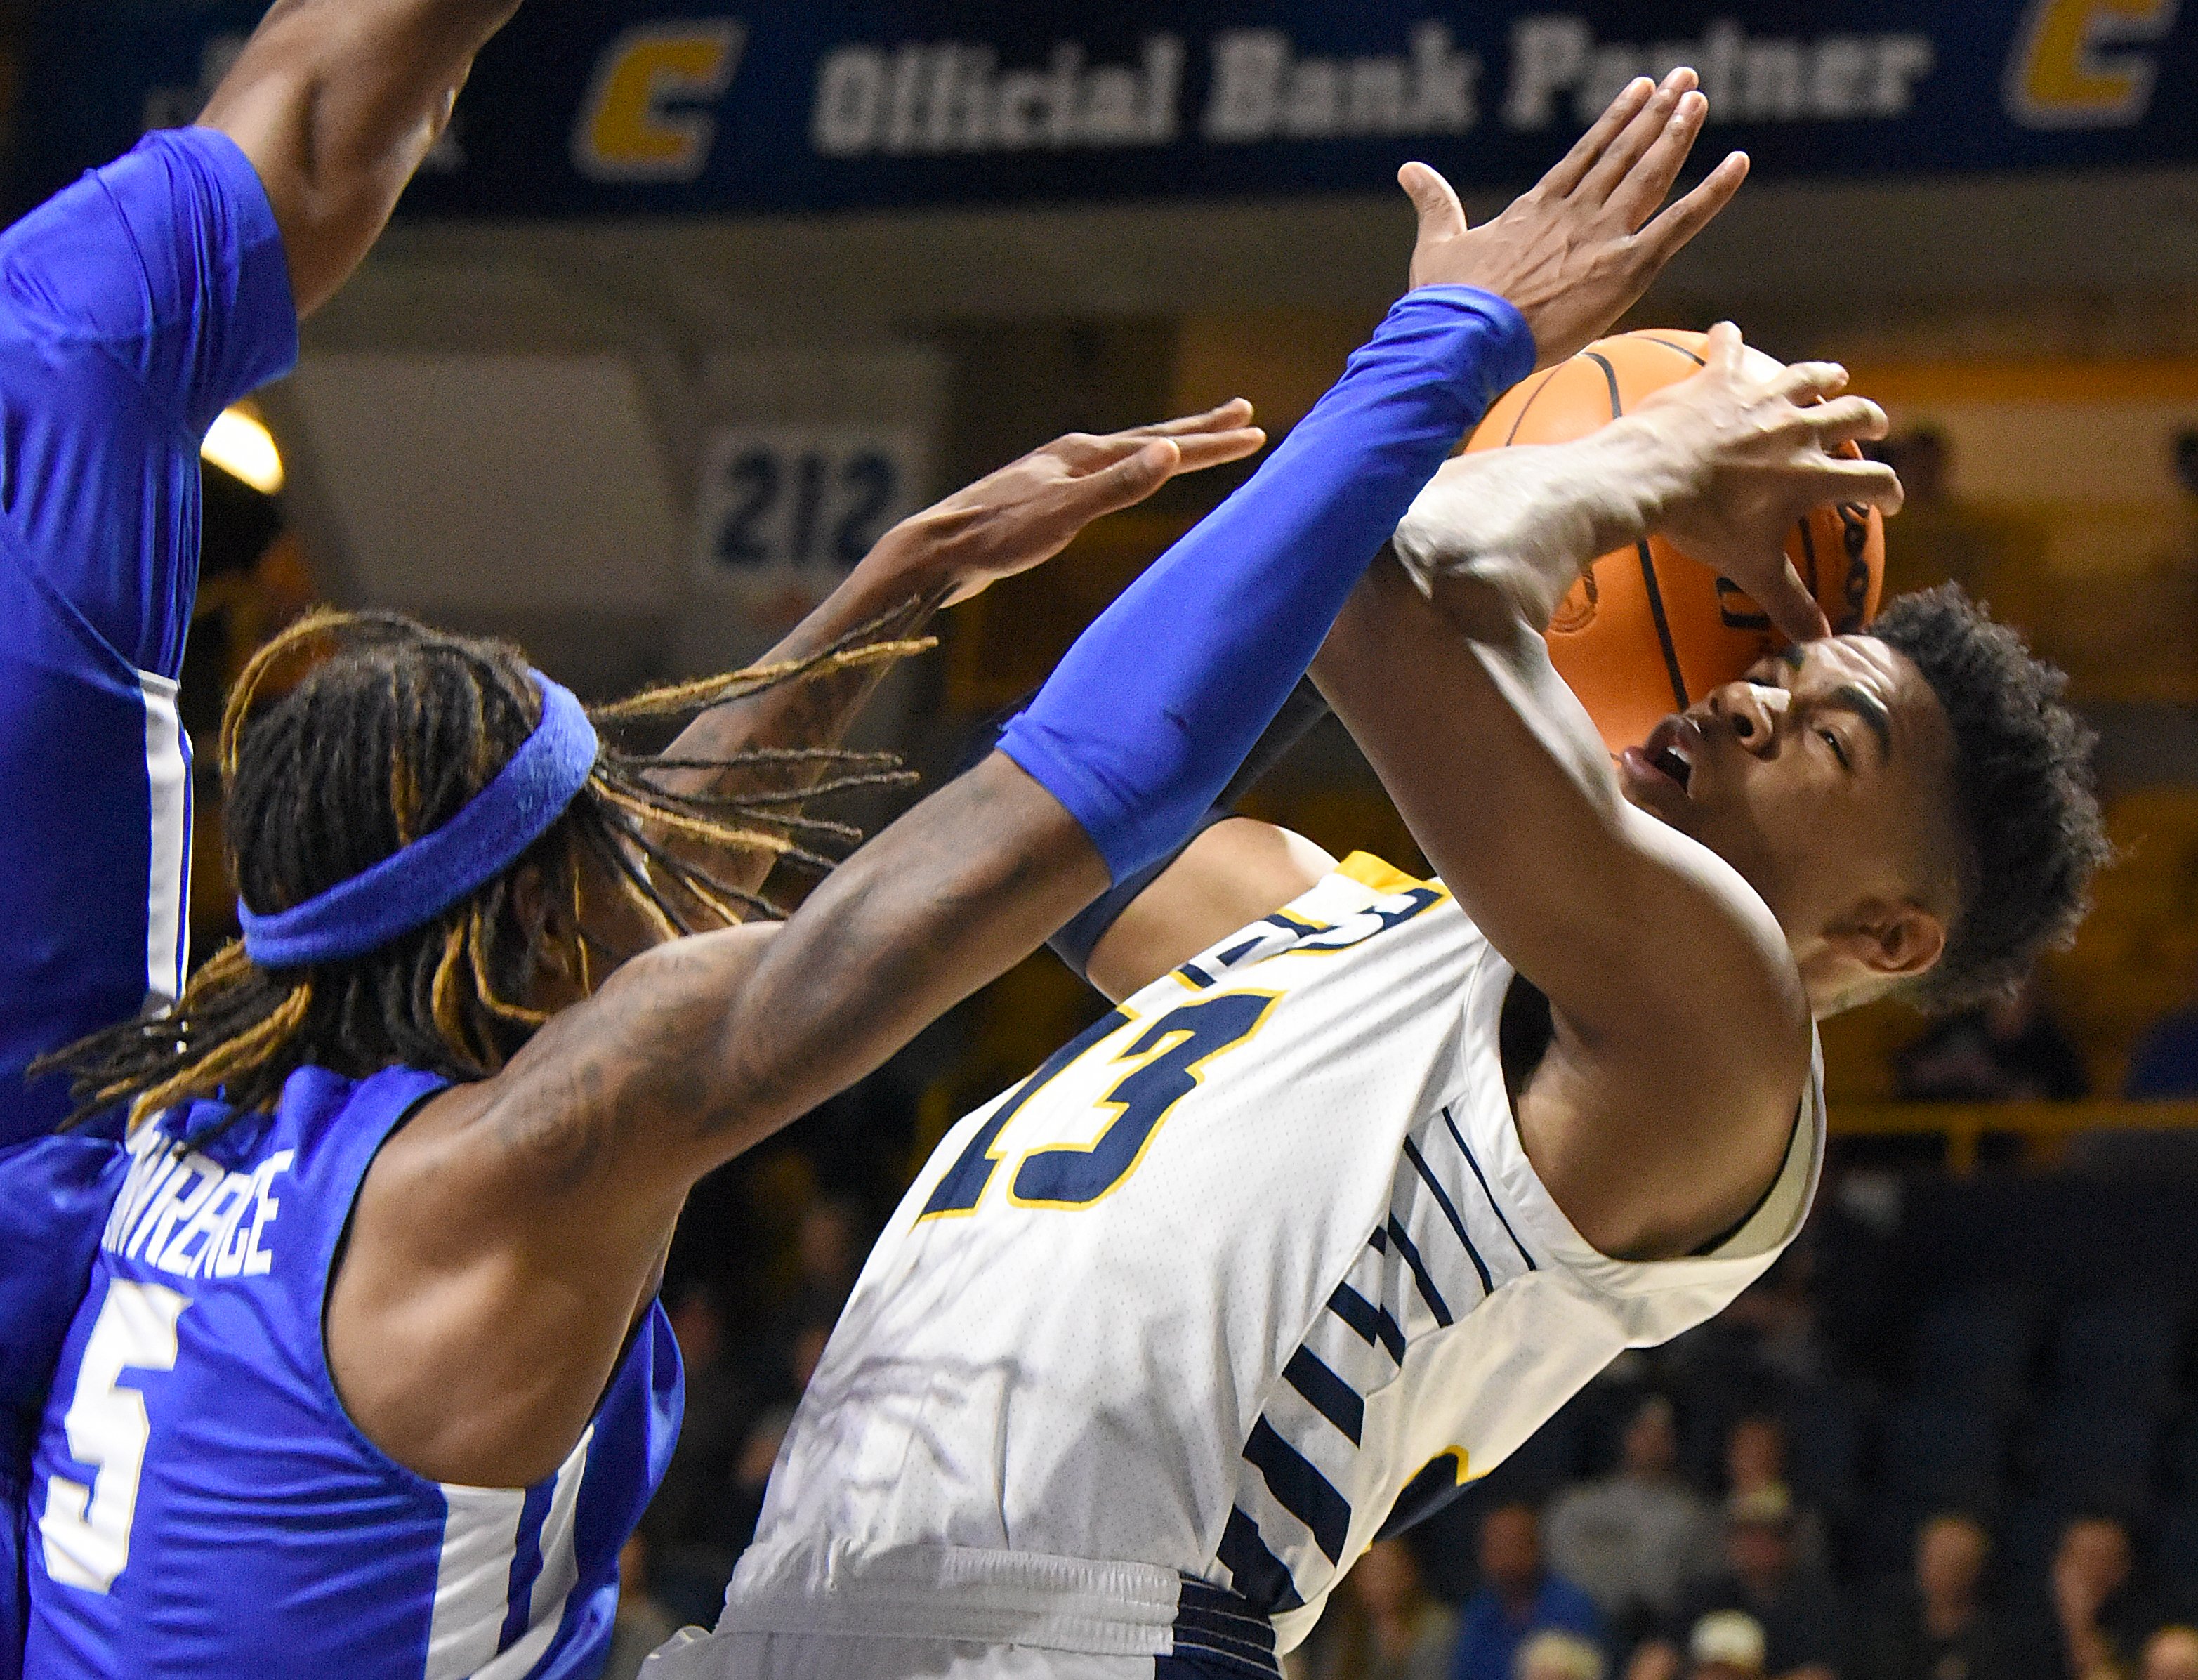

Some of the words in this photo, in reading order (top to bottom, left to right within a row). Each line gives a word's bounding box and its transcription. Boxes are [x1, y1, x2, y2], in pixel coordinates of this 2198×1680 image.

[815, 34, 1181, 156] Official
[1206, 25, 1476, 140] Bank
[713, 445, 898, 565] 212
[910, 989, 1288, 1231] 13
[40, 1278, 191, 1594] 5
